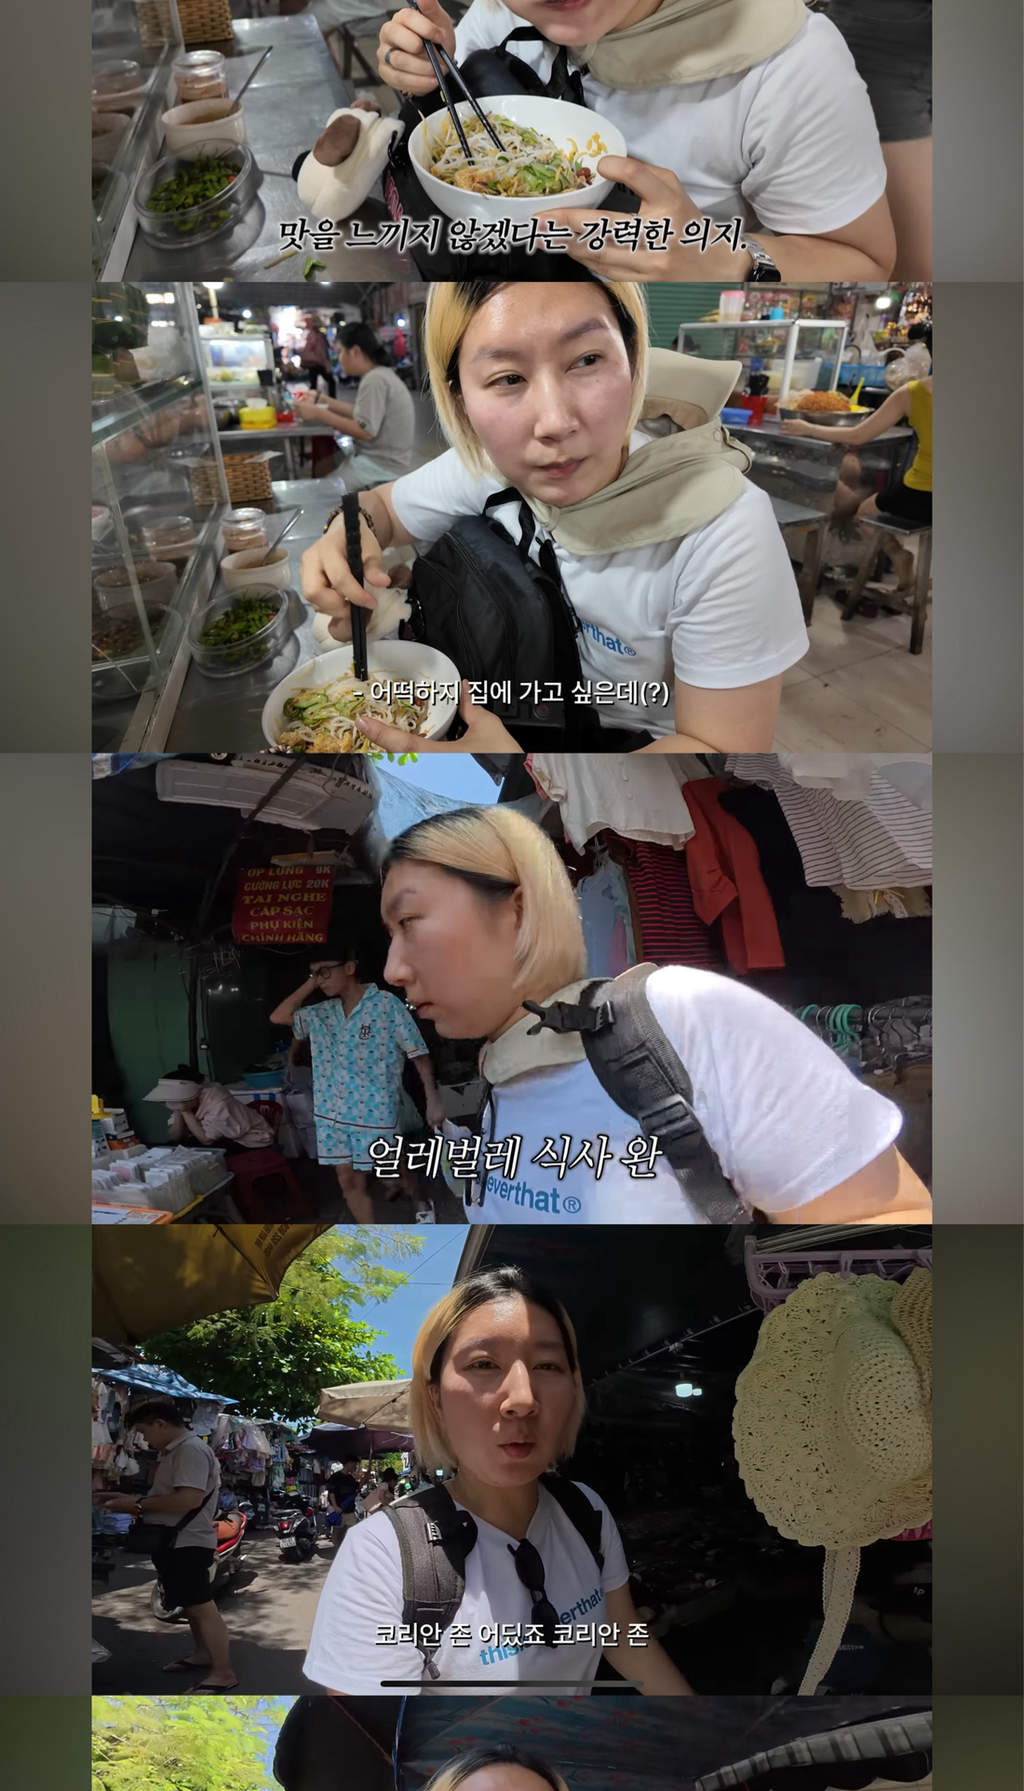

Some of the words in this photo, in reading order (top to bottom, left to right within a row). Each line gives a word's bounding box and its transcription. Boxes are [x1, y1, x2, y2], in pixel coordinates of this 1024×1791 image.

[306, 879, 330, 888] 20K
[242, 894, 273, 904] TAI
[277, 893, 327, 902] NGHE
[250, 920, 280, 931] PHỤ
[241, 932, 284, 942] CHÍNH
